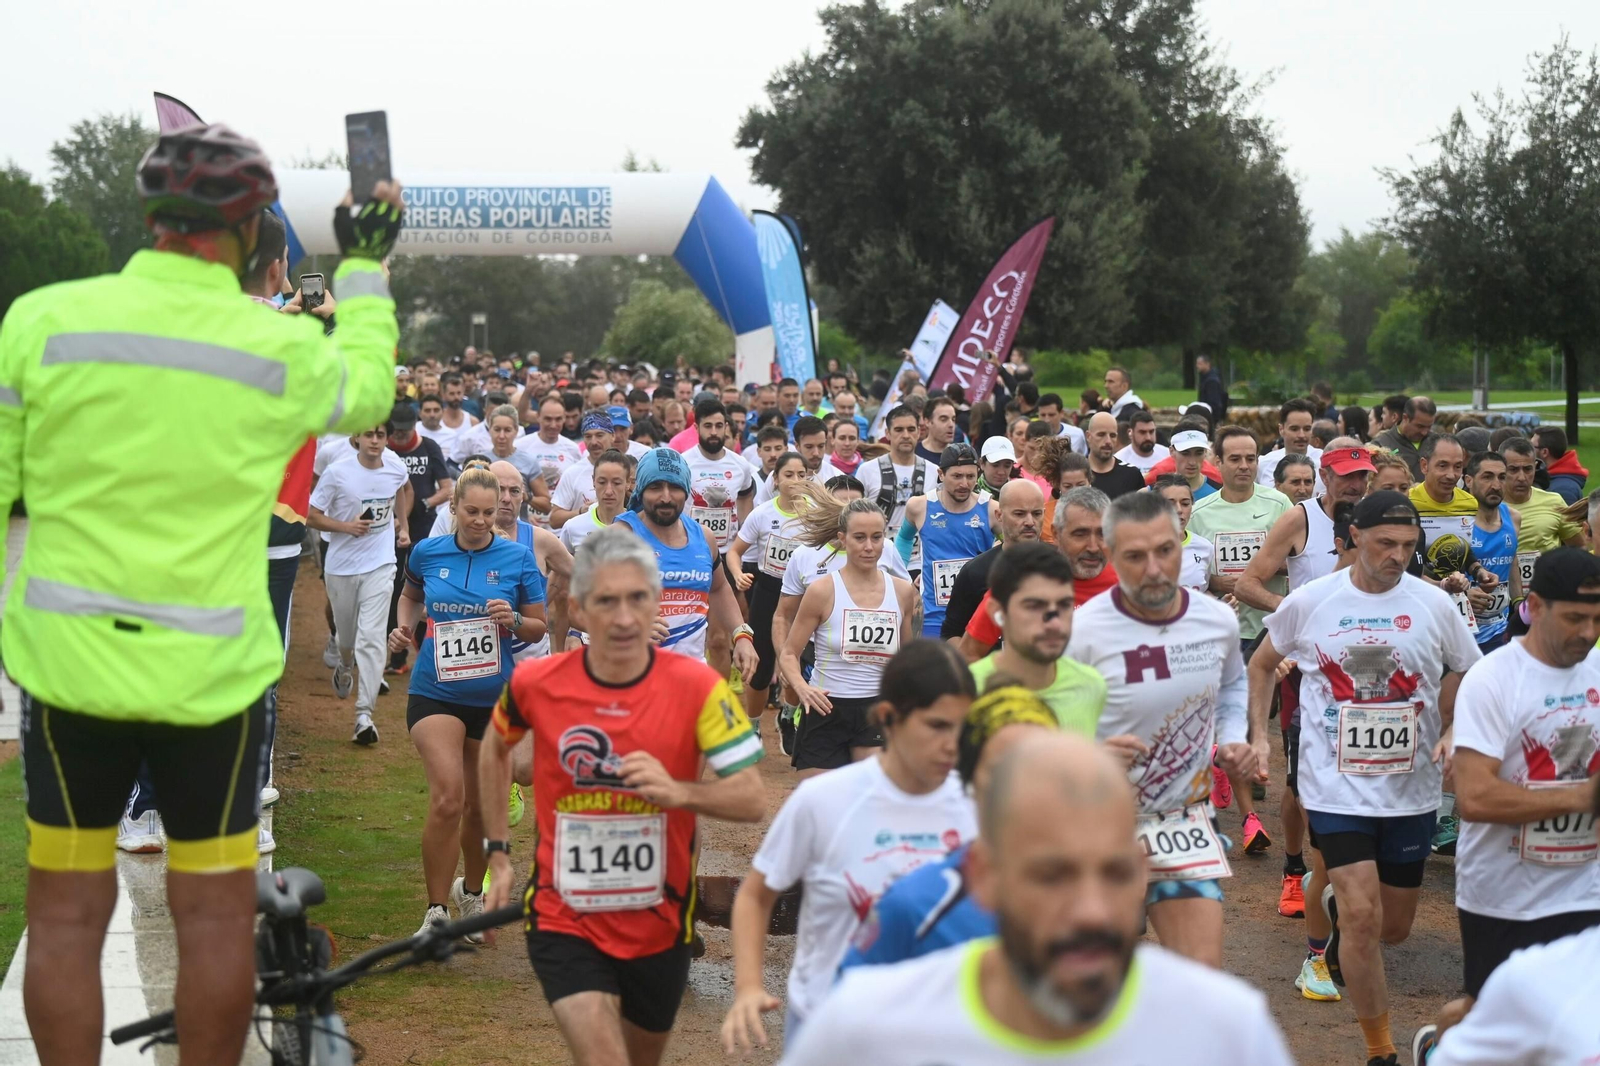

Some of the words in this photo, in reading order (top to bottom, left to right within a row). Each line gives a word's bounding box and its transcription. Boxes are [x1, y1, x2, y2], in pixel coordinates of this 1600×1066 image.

[400, 188, 459, 206] CUITO
[465, 188, 582, 206] PROVINCIAL
[588, 188, 612, 206] DE
[402, 206, 482, 228] RRERAS
[489, 206, 612, 228] POPULARES
[400, 229, 480, 244] UTACIÓN
[492, 231, 514, 244] DE
[526, 229, 613, 244] CÓRDOBA
[993, 313, 1014, 358] eportes
[375, 505, 391, 521] 57
[659, 569, 710, 583] nerplus
[432, 602, 490, 615] enerplu
[1394, 617, 1410, 628] aje
[848, 625, 895, 645] 1027
[441, 635, 493, 659] 1146
[1168, 644, 1183, 655] 35
[1347, 726, 1410, 749] 1104
[1137, 828, 1210, 858] 1008
[568, 842, 655, 874] 1140
